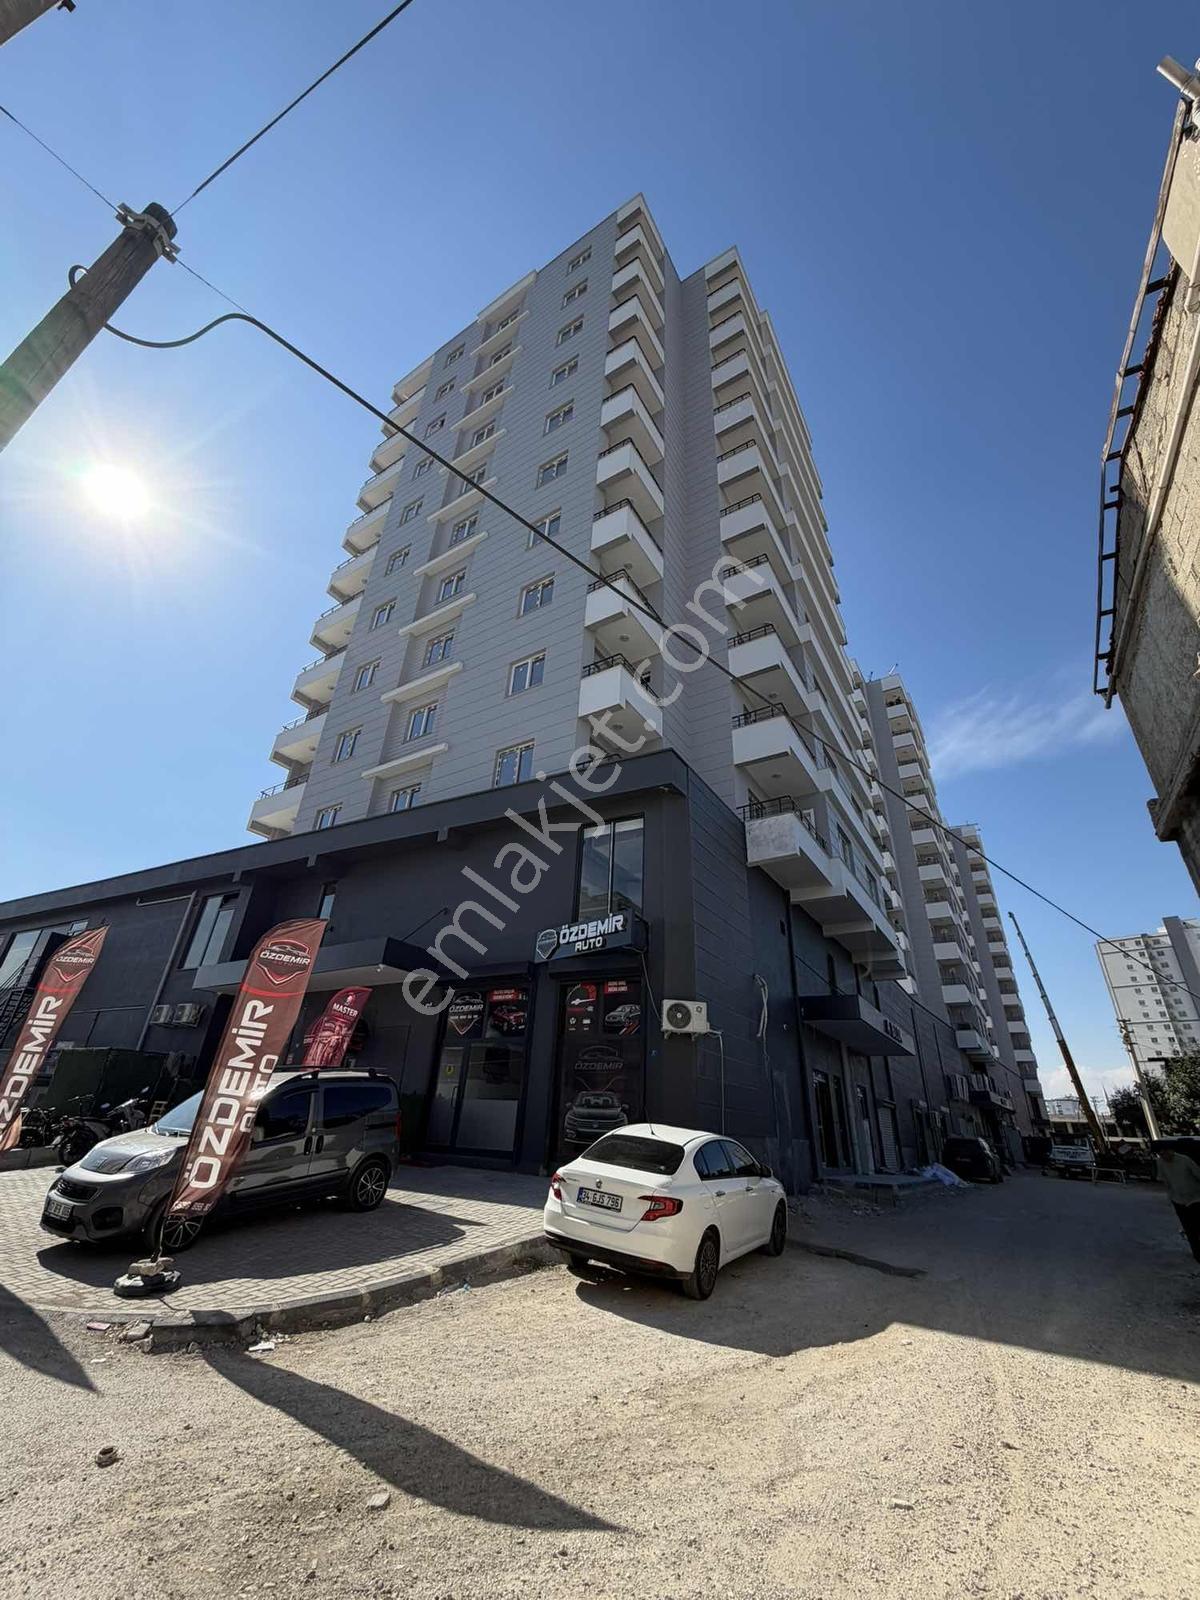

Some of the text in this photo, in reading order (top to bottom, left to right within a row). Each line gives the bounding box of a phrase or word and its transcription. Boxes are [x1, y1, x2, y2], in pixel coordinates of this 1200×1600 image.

[560, 913, 624, 944] ÖZDEMİR
[575, 937, 602, 952] AUTO
[332, 1003, 358, 1017] MASTER
[0, 996, 63, 1130] ZDEMİR
[184, 1000, 274, 1189] ÖZDEMİR
